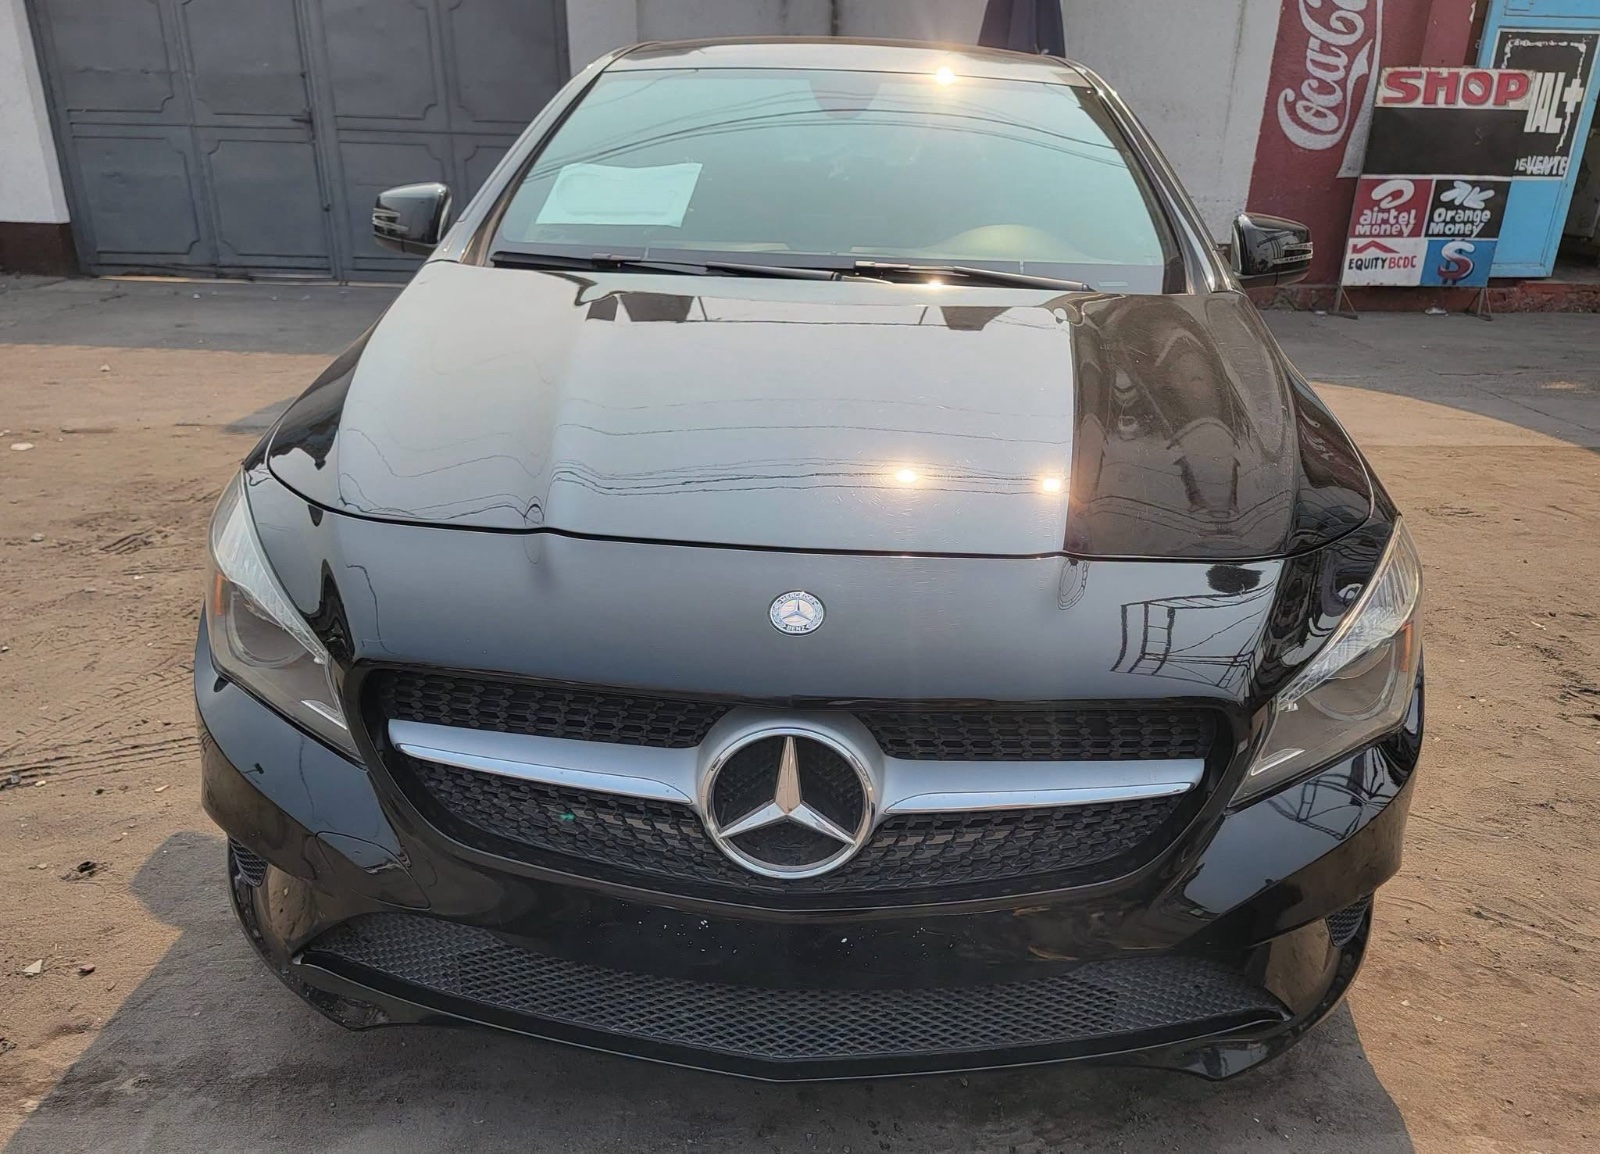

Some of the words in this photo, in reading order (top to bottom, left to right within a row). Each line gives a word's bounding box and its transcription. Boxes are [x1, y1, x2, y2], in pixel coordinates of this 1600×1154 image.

[1382, 70, 1530, 106] SHOP
[1359, 206, 1417, 225] airtel
[1433, 207, 1491, 225] Orange
[1428, 222, 1485, 238] Money
